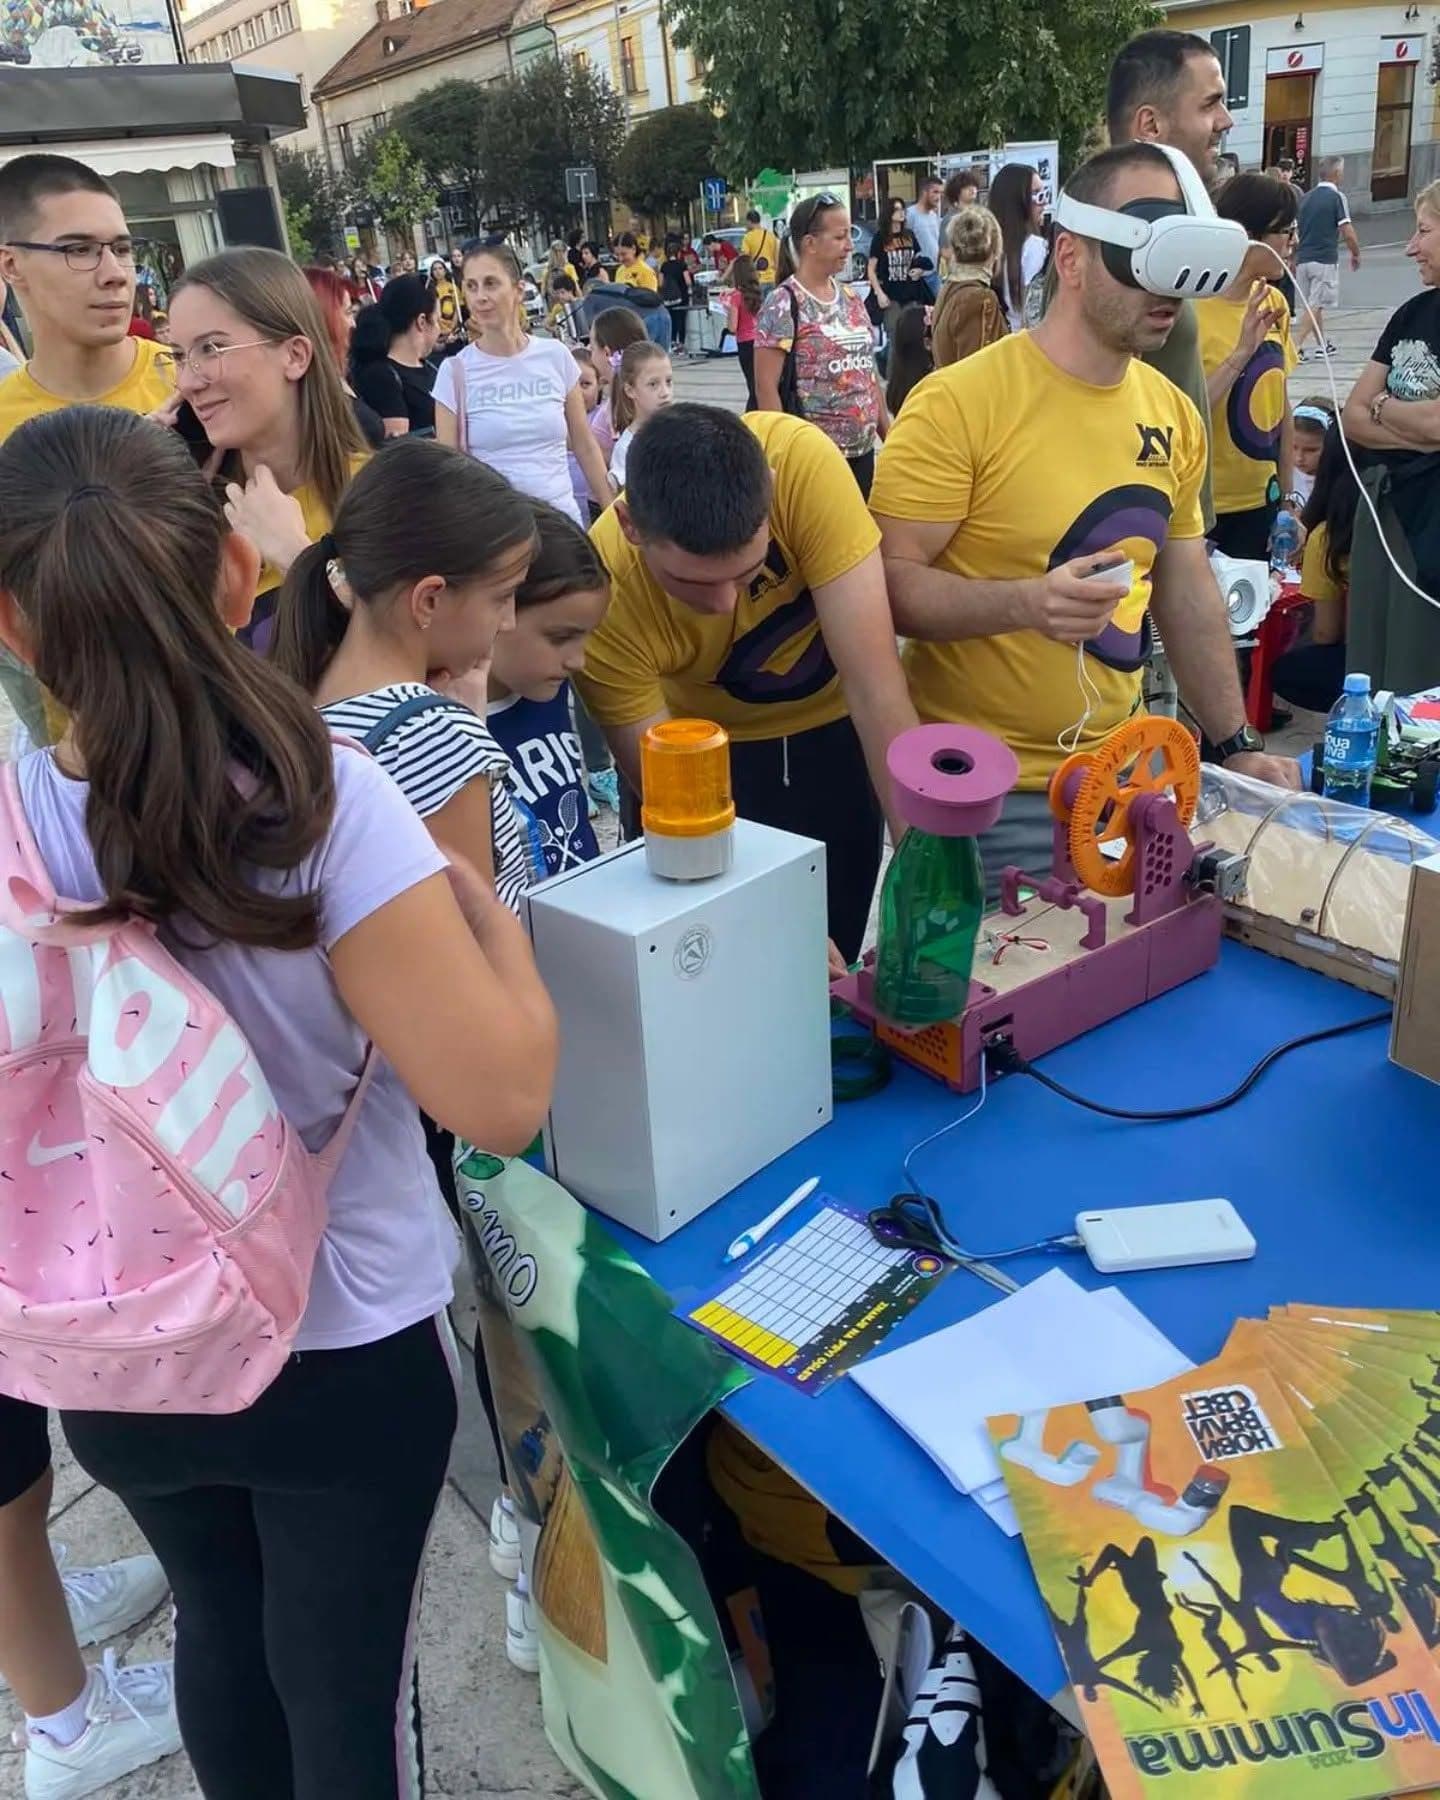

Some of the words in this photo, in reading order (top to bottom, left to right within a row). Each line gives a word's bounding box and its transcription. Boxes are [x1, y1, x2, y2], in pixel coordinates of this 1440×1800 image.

[828, 353, 873, 374] adidas
[1184, 1390, 1251, 1420] СВЕТ
[1124, 1689, 1440, 1777] InSumma
